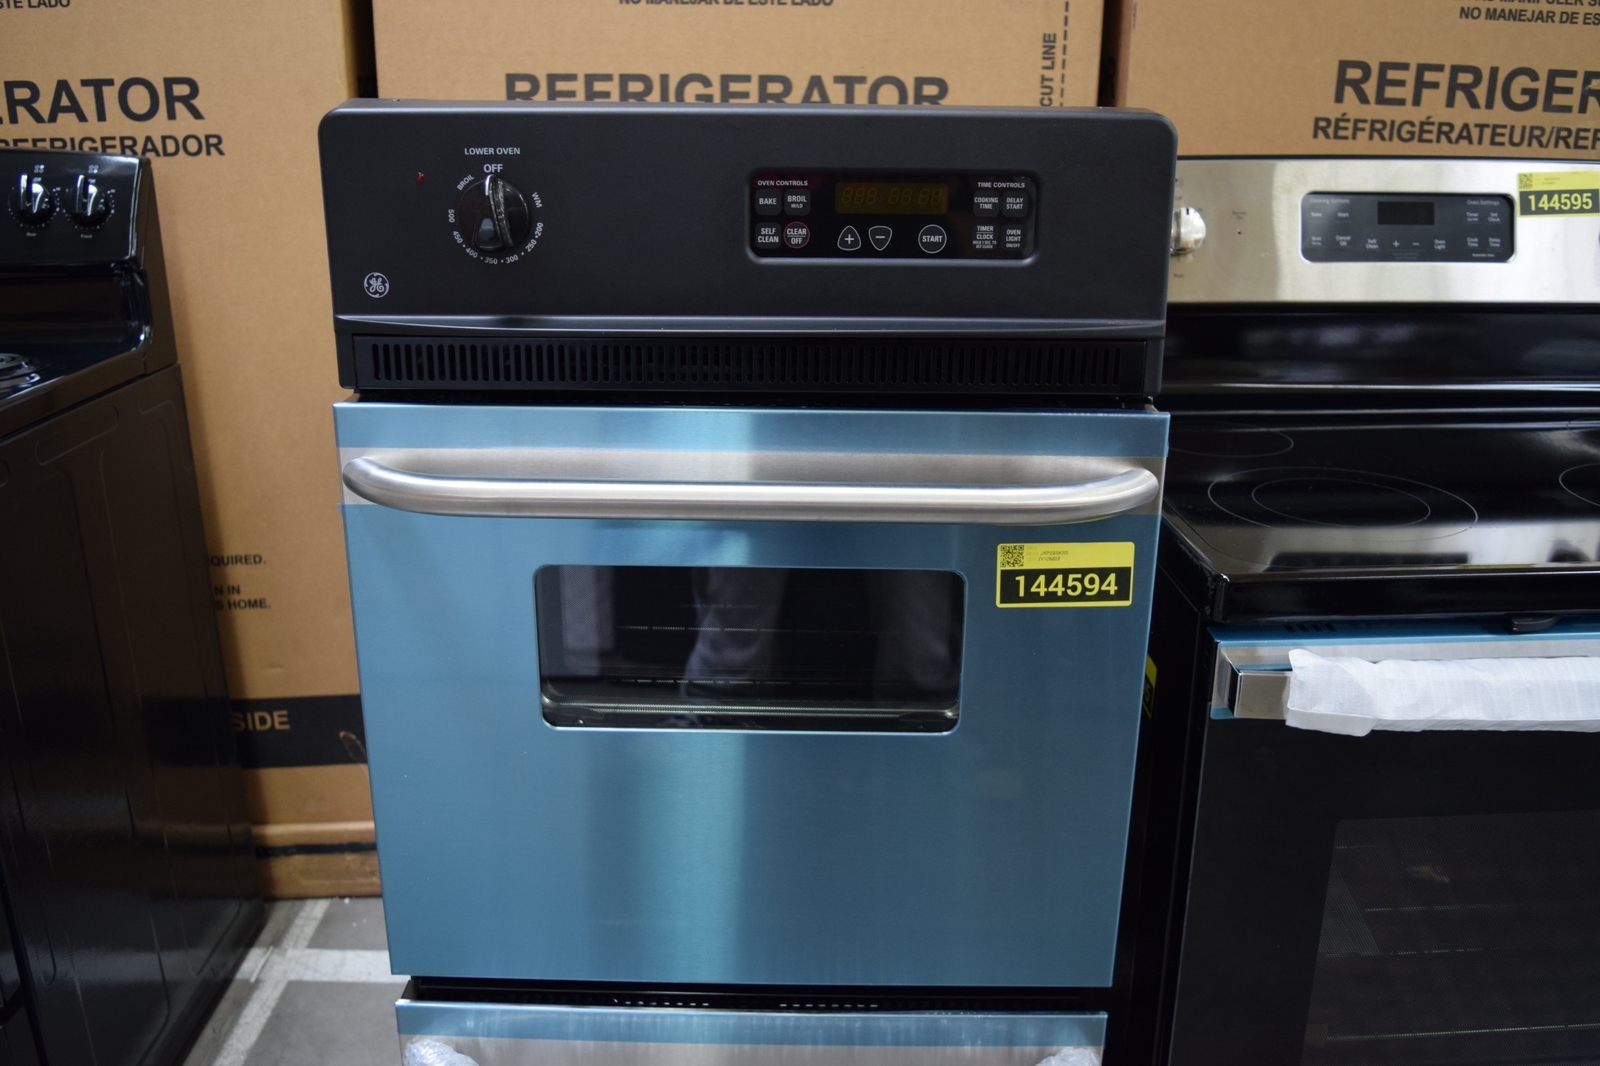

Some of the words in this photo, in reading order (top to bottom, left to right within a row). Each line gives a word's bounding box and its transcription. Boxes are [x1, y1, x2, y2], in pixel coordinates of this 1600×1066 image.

[1459, 6, 1482, 20] NO
[1485, 7, 1556, 24] MANEJAR
[1559, 11, 1580, 25] DE
[1042, 33, 1057, 70] LINE
[505, 73, 949, 105] REFRIGERATOR
[1039, 74, 1054, 107] CUT
[0, 76, 206, 125] RATOR
[464, 147, 495, 155] LOWER
[496, 147, 521, 155] OVEN
[483, 164, 503, 173] OFF
[457, 174, 474, 191] BROIL
[532, 192, 542, 208] WM
[787, 195, 807, 203] BROIL
[1528, 193, 1593, 211] 144595
[535, 222, 544, 236] 200
[453, 230, 463, 244] 450
[466, 247, 478, 258] 400
[525, 239, 537, 252] 250
[484, 256, 498, 264] 350
[505, 254, 519, 263] 300
[227, 585, 241, 595] IN
[1015, 573, 1118, 597] 144594
[227, 598, 272, 610] HOME.
[232, 709, 291, 733] SIDE
